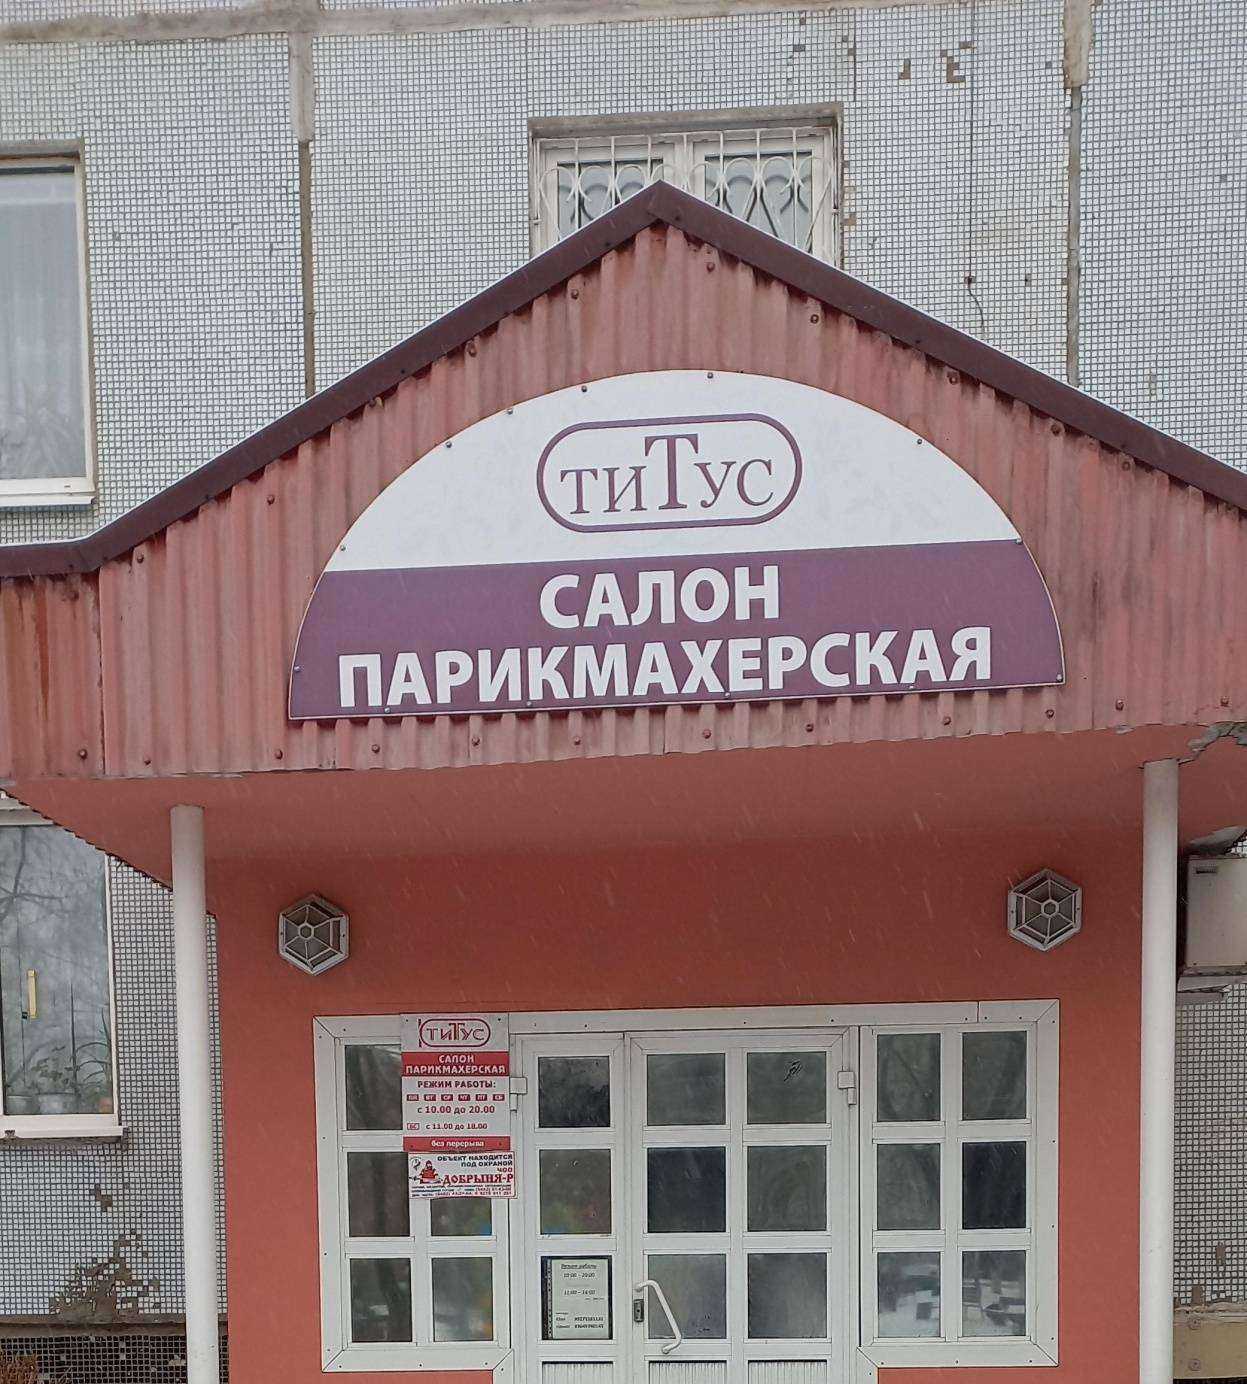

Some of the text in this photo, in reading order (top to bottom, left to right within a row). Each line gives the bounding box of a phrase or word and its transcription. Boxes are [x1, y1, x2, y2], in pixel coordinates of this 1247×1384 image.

[538, 566, 780, 630] САЛОН
[338, 626, 993, 708] ПАРИКМАХЕРСКАЯ
[438, 1054, 475, 1064] САЛОН
[405, 1064, 506, 1074] ПАРИКМАХЕРСКАЯ
[454, 1080, 496, 1088] РАБОТЫ:
[425, 1105, 452, 1113] 10.00
[468, 1105, 495, 1113] 20.00
[446, 1140, 485, 1148] перерыва
